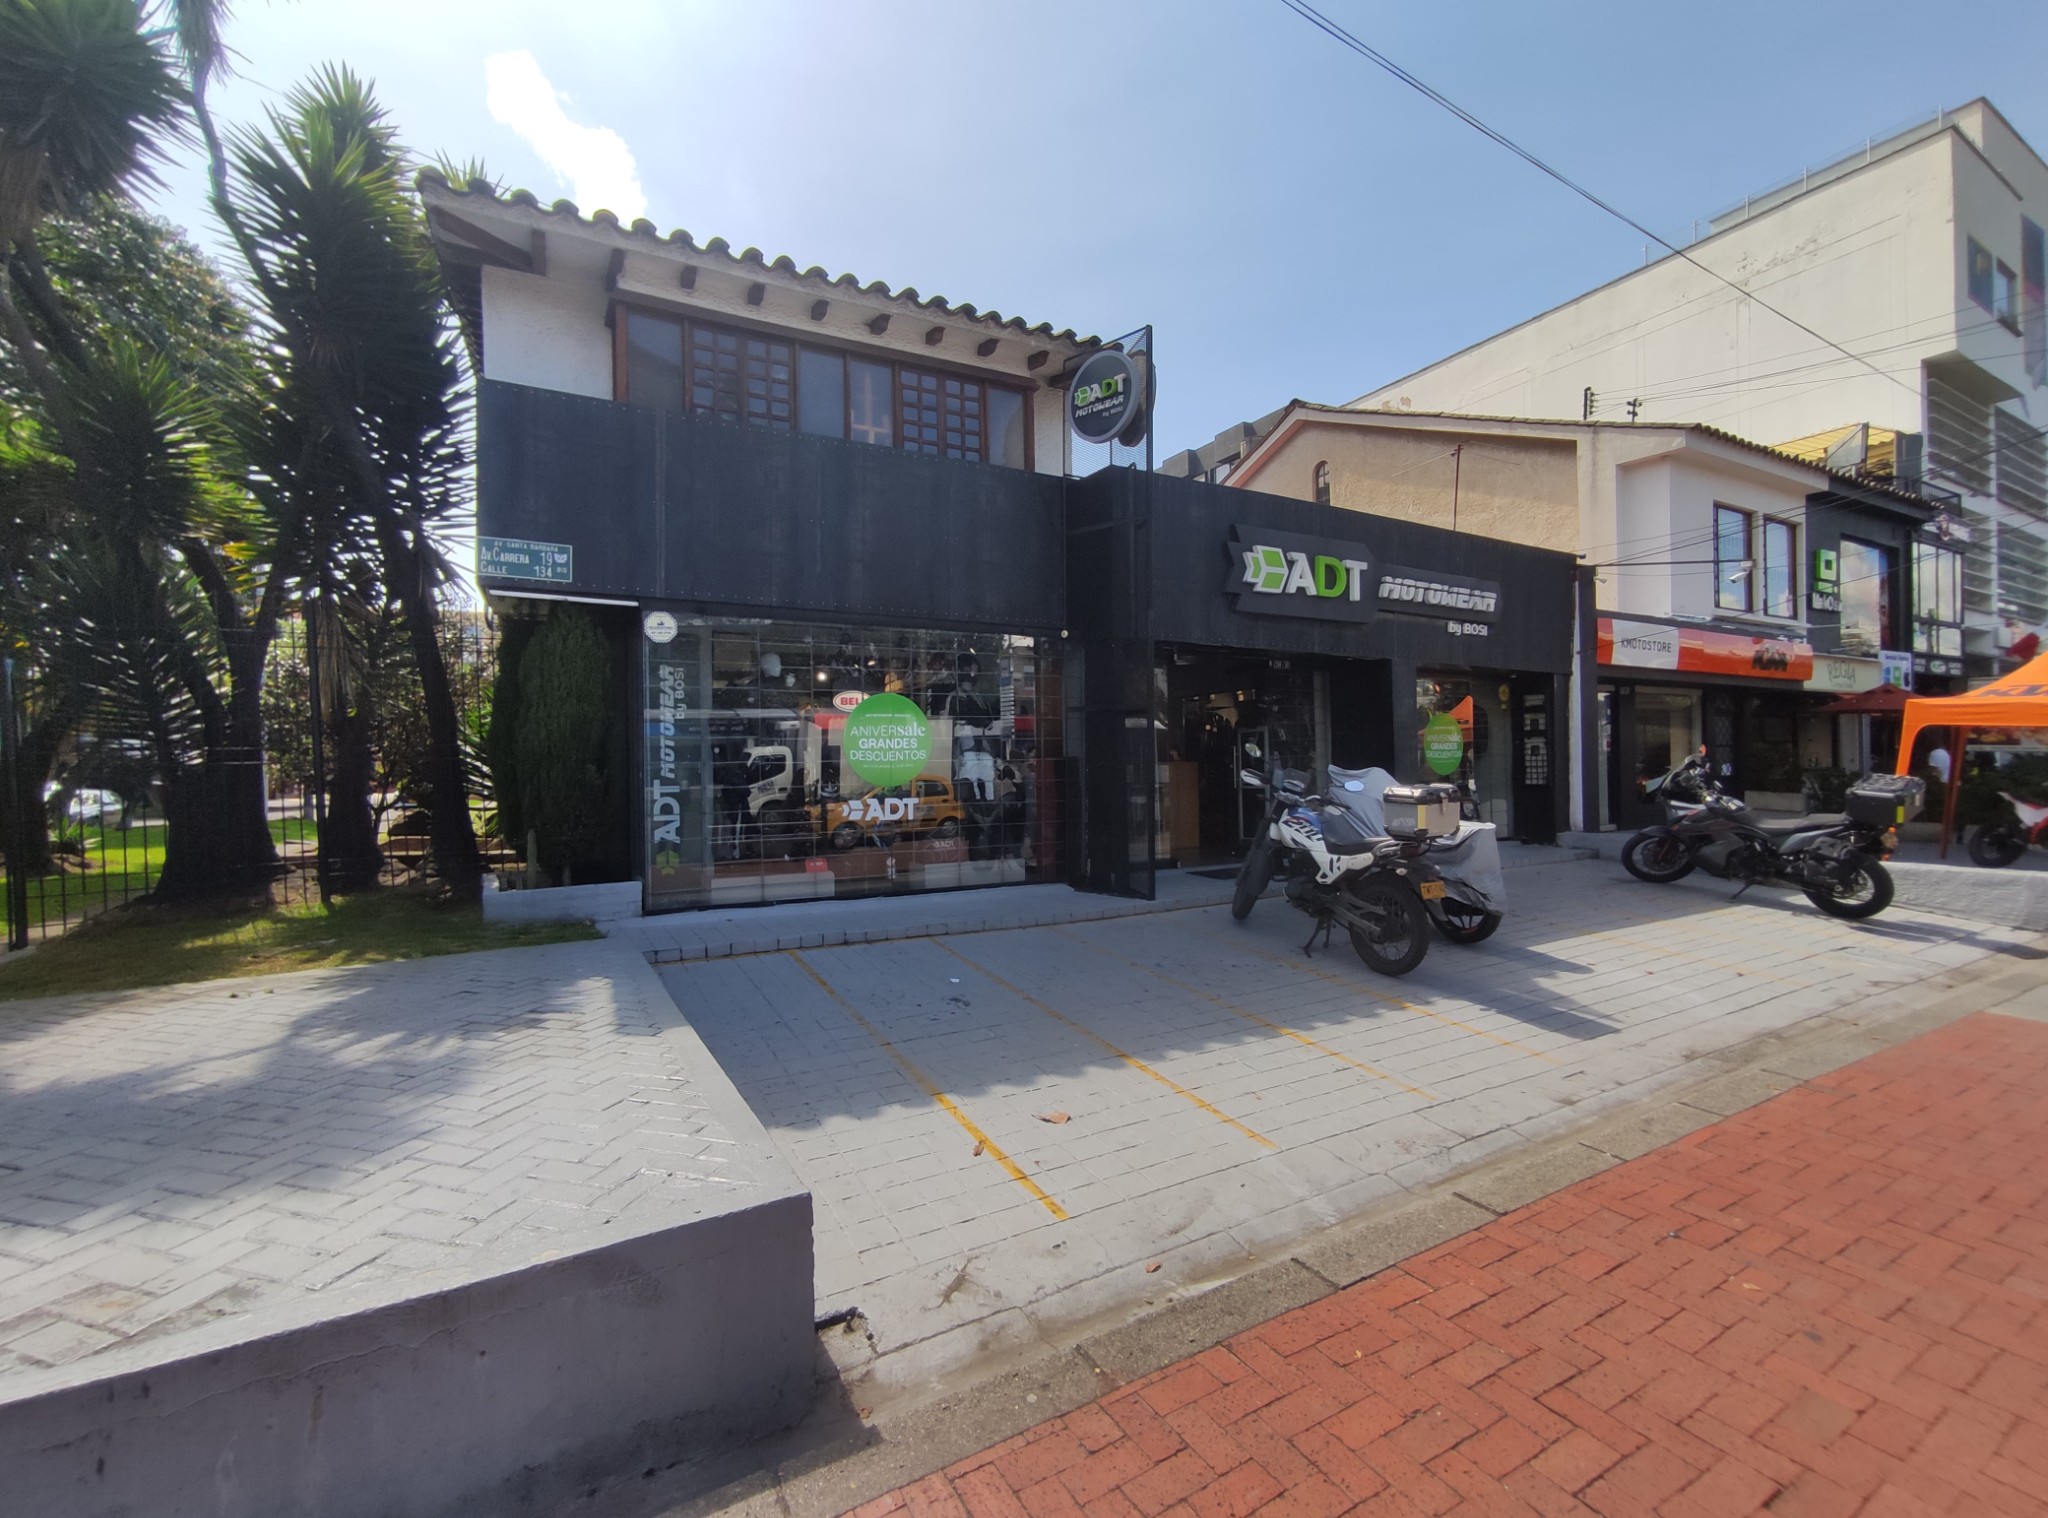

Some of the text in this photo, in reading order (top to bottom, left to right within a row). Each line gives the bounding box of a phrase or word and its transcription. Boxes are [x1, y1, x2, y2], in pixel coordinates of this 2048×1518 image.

[1090, 373, 1127, 402] ADT
[540, 552, 553, 566] 19
[533, 565, 553, 578] 134
[1286, 551, 1368, 602] ADT
[1378, 576, 1497, 612] MOTOWEAR
[1447, 620, 1488, 636] by BOSI
[1621, 637, 1672, 653] KMOTOSTORE
[674, 667, 687, 720] by BOSI
[840, 696, 860, 706] BEL
[850, 722, 926, 737] ANIVERsale
[858, 738, 918, 749] GRANDES
[849, 750, 927, 761] DESCUENTOS
[653, 779, 681, 844] ADT
[864, 797, 920, 821] ADT
